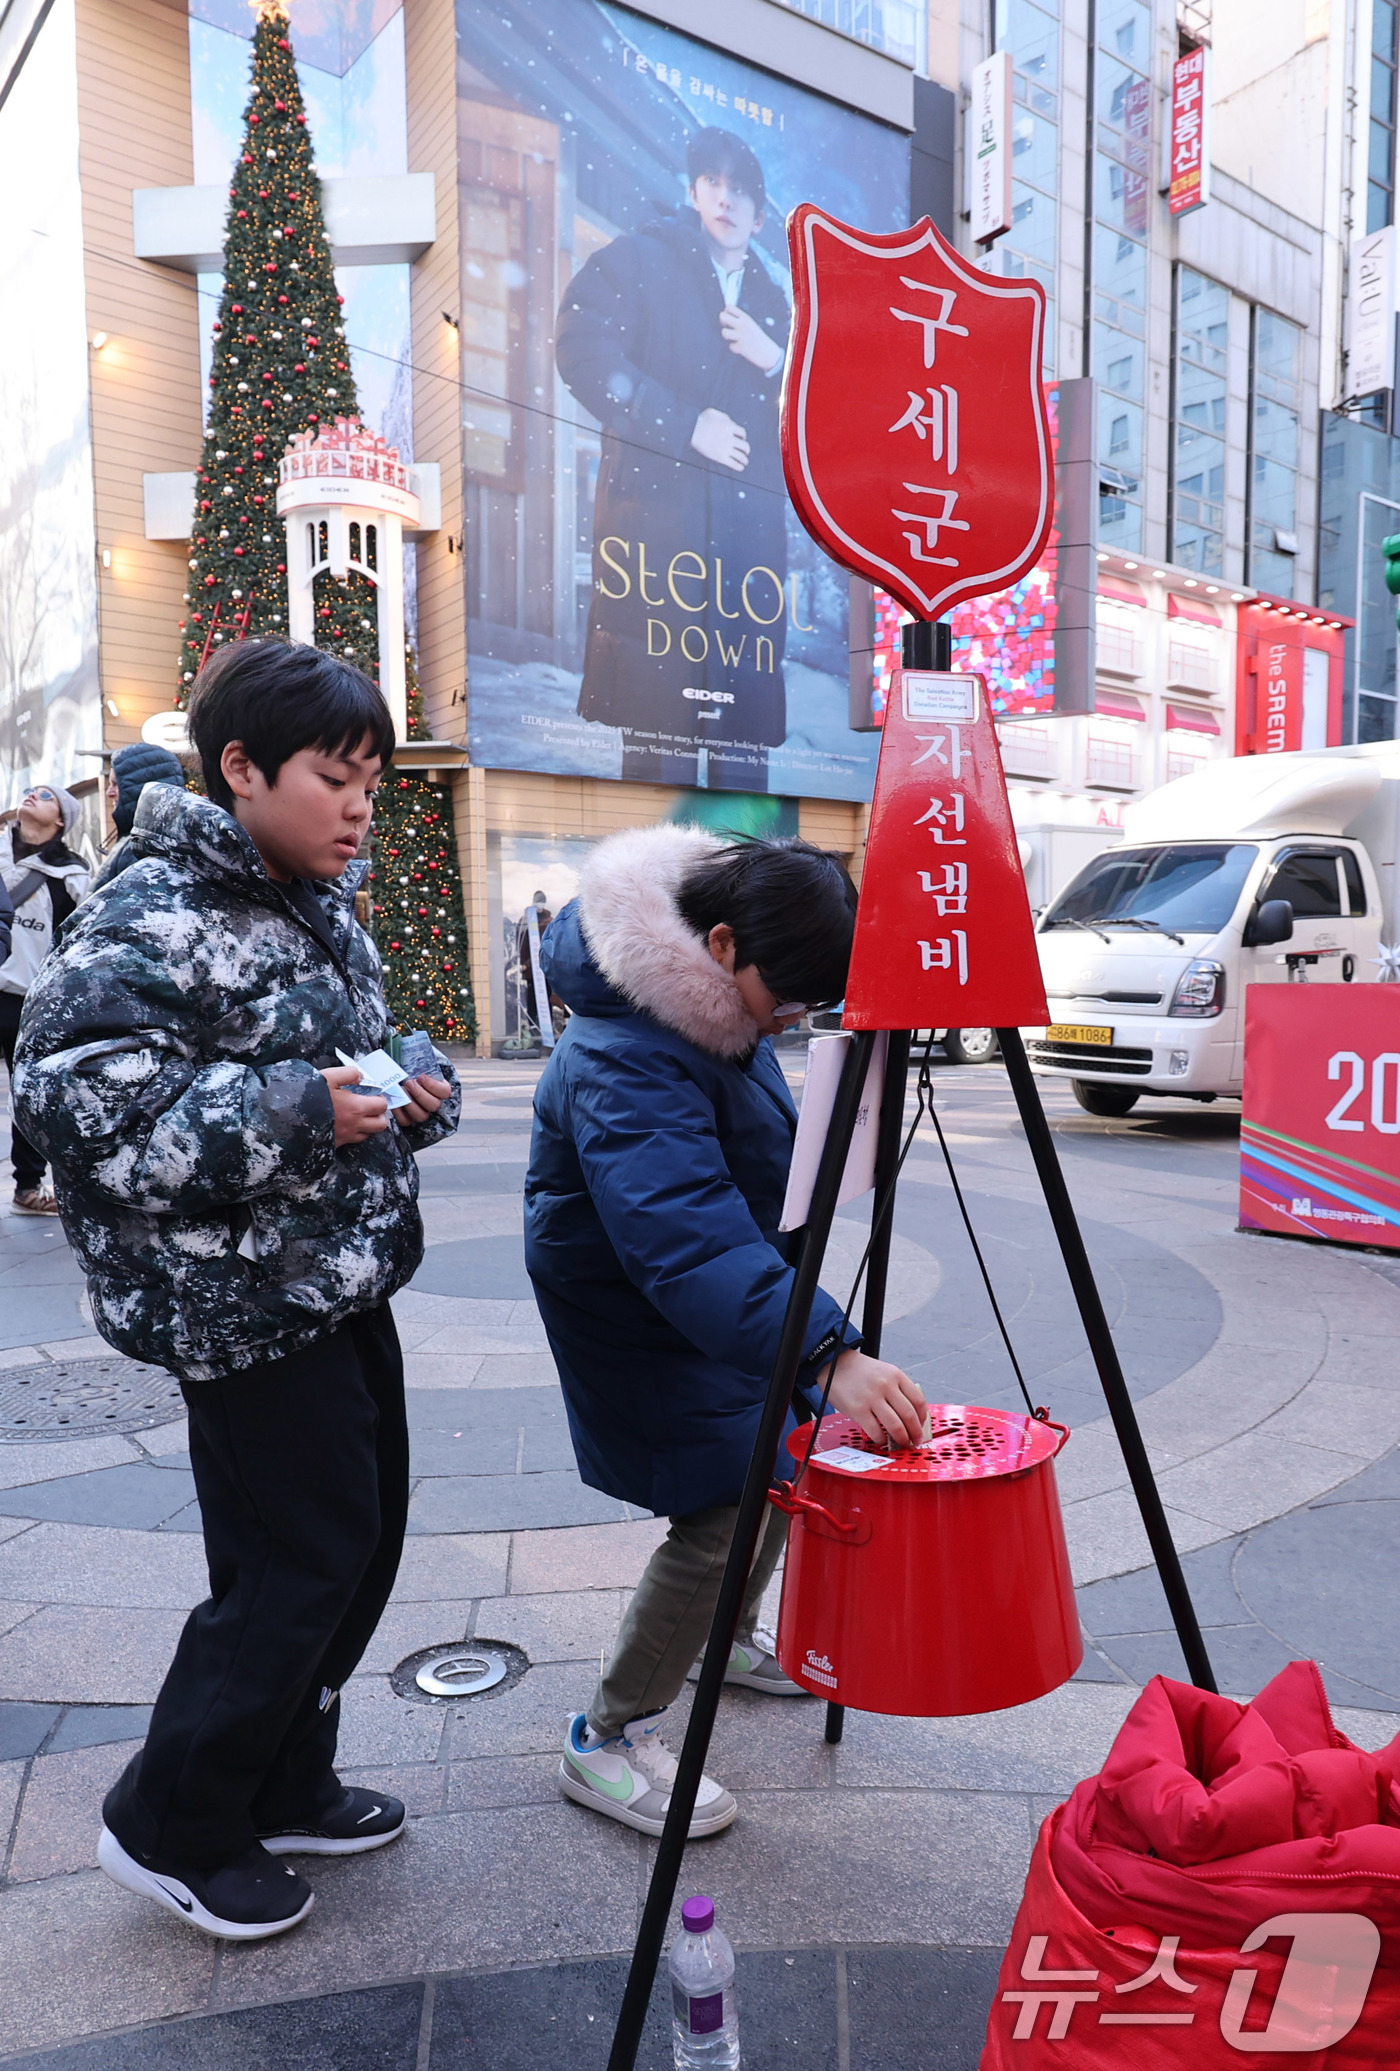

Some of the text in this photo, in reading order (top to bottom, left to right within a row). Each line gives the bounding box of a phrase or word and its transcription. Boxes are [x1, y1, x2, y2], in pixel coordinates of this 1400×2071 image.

[1175, 52, 1204, 84] 현대
[689, 76, 728, 108] 감싸는
[734, 96, 774, 126] 따뜻함
[1173, 78, 1201, 173] 부동산
[888, 275, 970, 567] 구세군
[1269, 644, 1287, 676] the
[682, 687, 735, 704] EIDER
[521, 715, 551, 727] EIDER
[584, 723, 597, 733] the
[634, 730, 657, 740] season
[658, 731, 673, 741] love
[694, 736, 704, 745] for
[704, 739, 732, 749] everyone
[733, 740, 759, 752] looking
[543, 734, 580, 747] Presented
[580, 737, 591, 749] by
[620, 742, 648, 754] Agency:
[649, 744, 673, 756] Veritas
[747, 755, 759, 767] My
[911, 724, 972, 986] 자선냄비
[1080, 1028, 1107, 1043] 1086
[380, 1073, 402, 1088] 1000
[1325, 1051, 1400, 1134] 20
